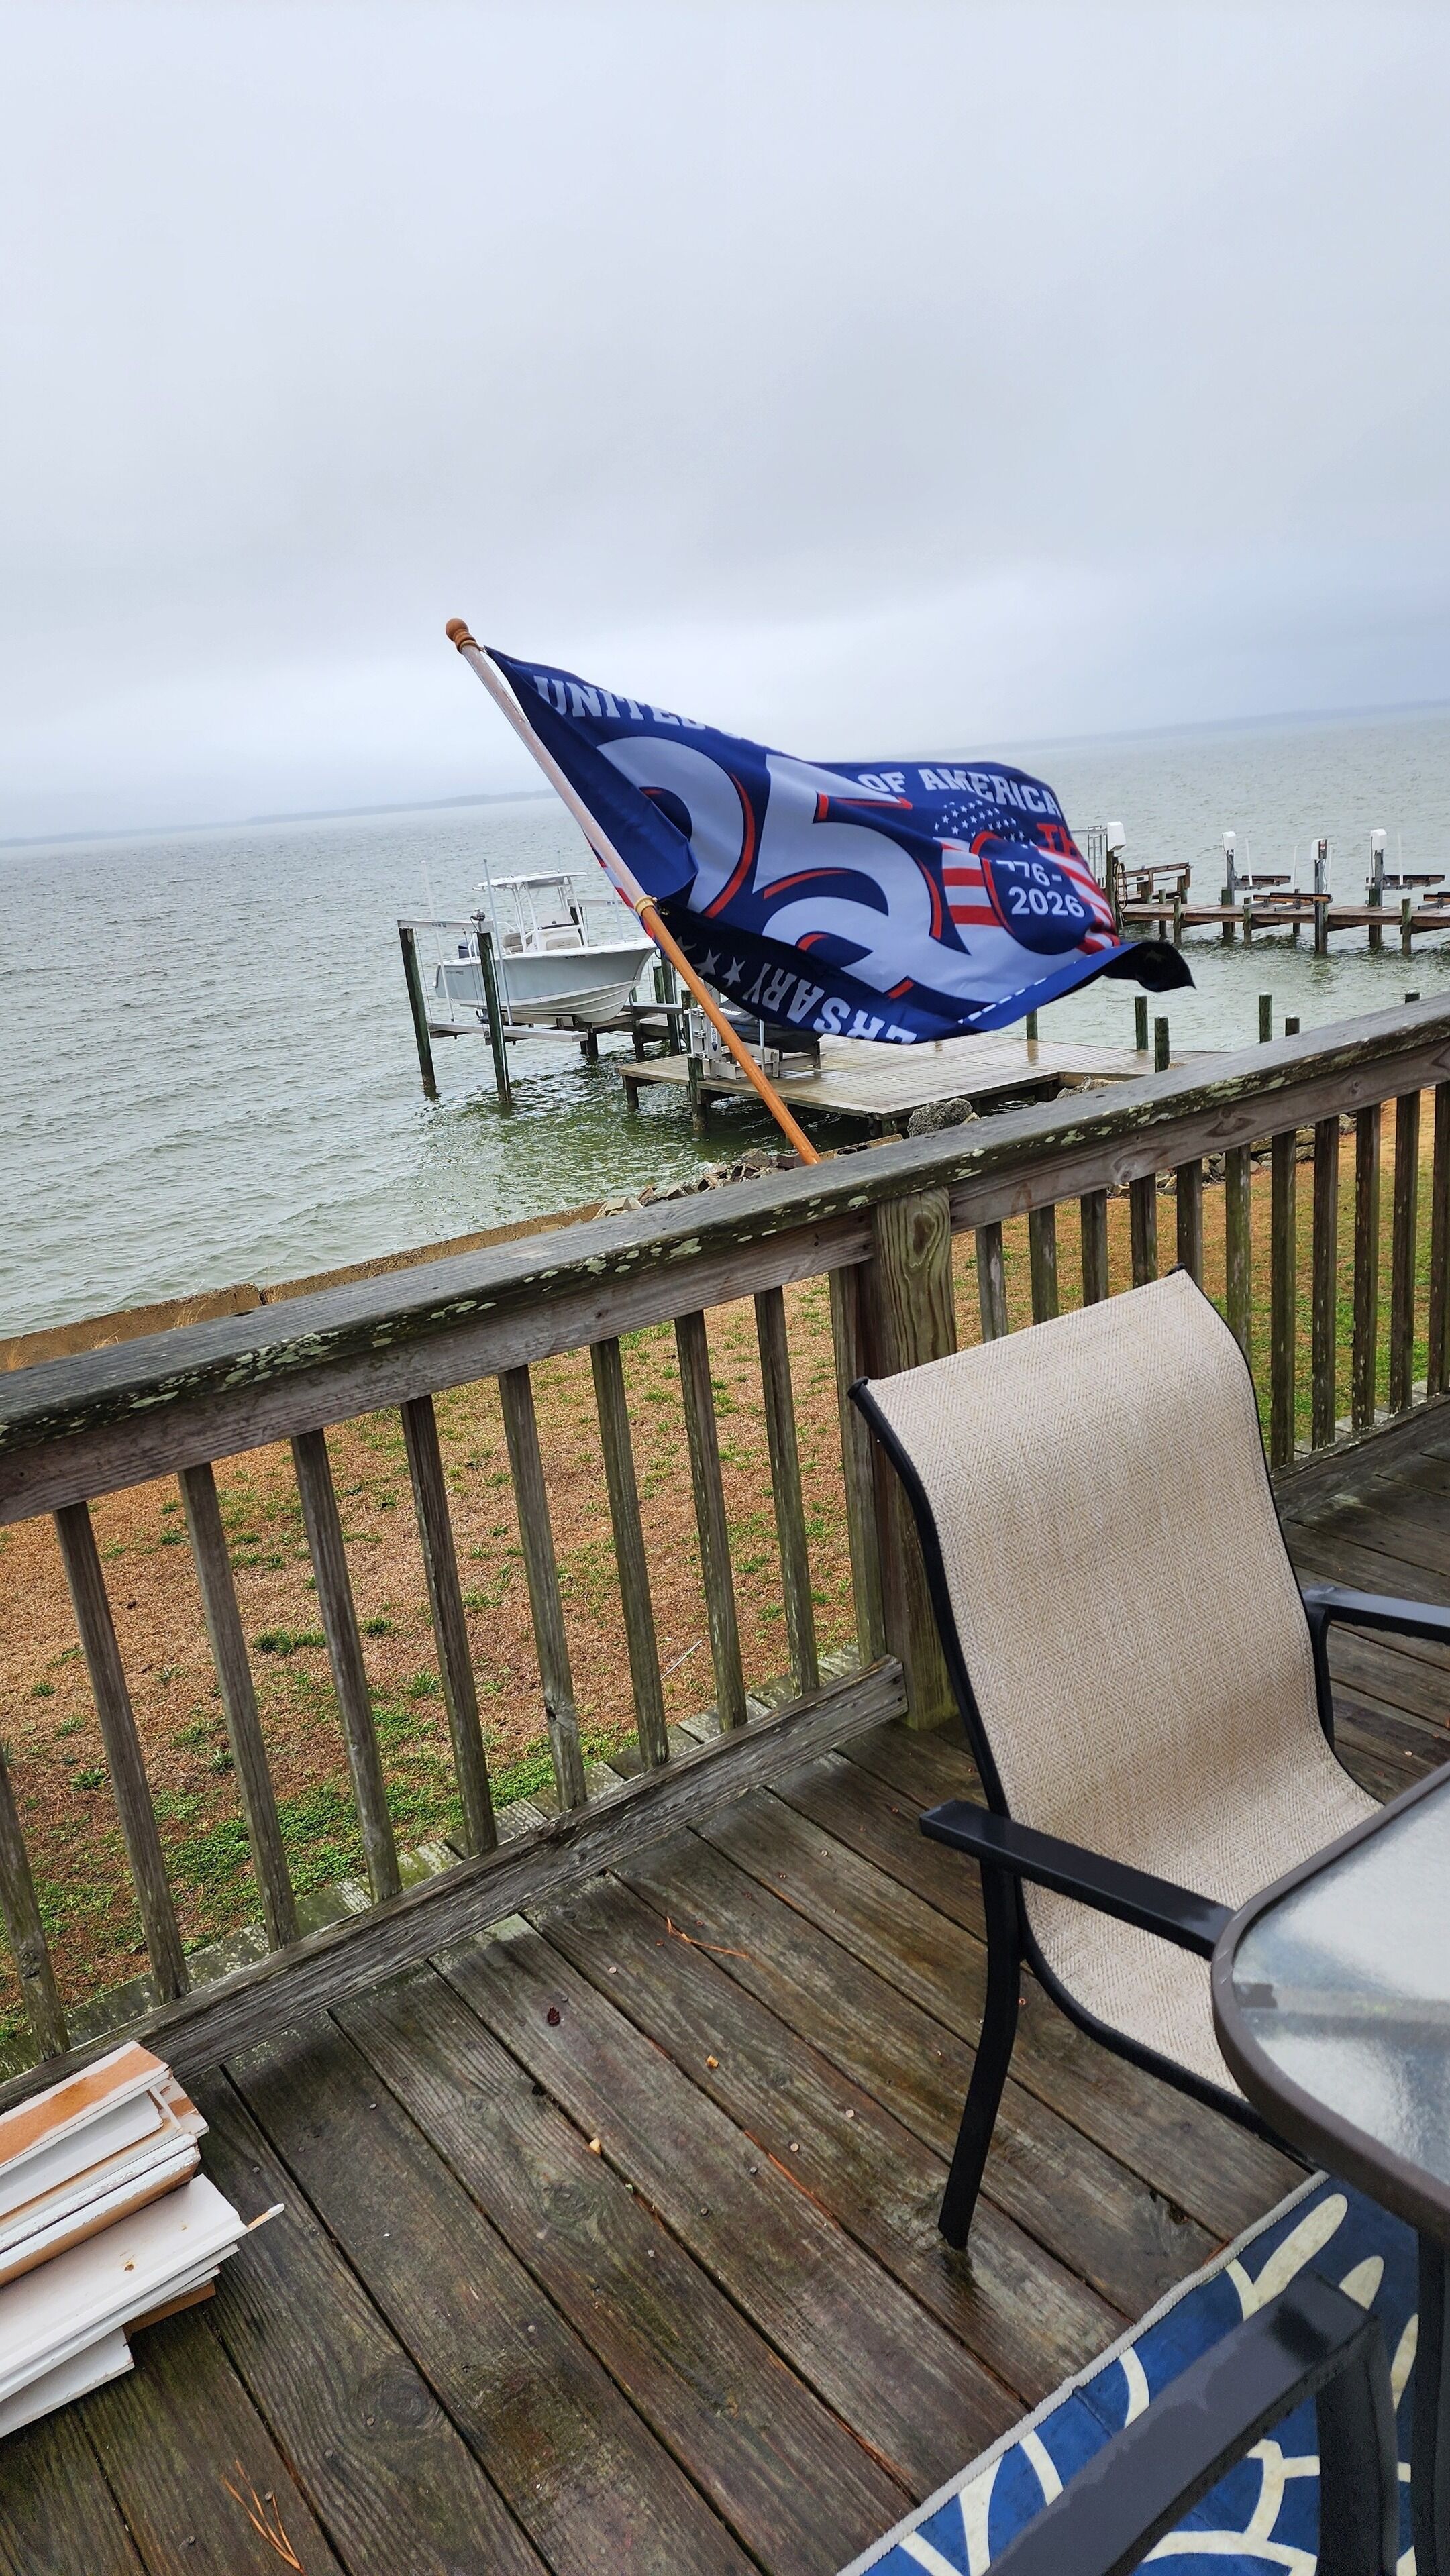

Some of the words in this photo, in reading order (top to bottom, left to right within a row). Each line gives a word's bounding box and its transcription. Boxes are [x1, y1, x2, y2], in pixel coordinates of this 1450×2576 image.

[858, 772, 906, 793] OF
[918, 769, 1062, 818] AMERICA
[1008, 886, 1085, 918] 2026
